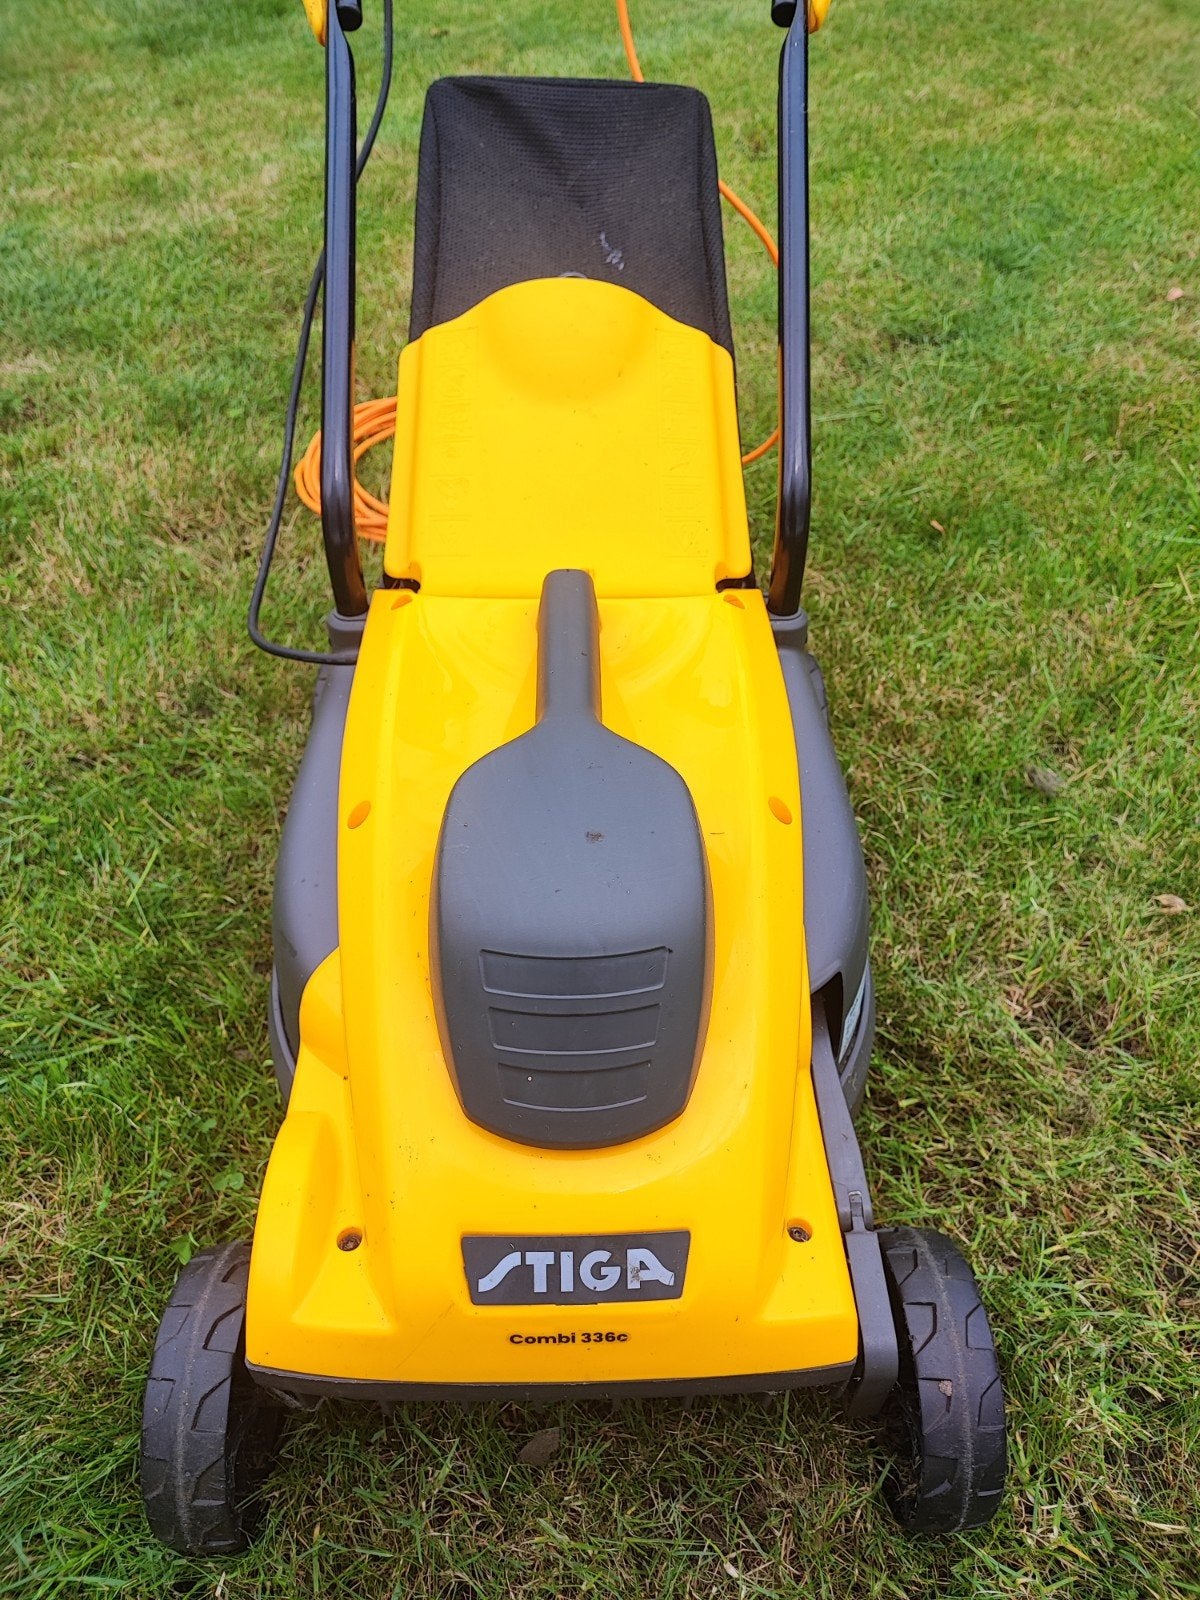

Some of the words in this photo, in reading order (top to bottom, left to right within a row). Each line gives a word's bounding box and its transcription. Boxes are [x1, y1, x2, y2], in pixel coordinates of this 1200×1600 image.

[478, 1248, 675, 1293] STIGA
[509, 1332, 576, 1345] Combi
[580, 1331, 628, 1344] 336c
